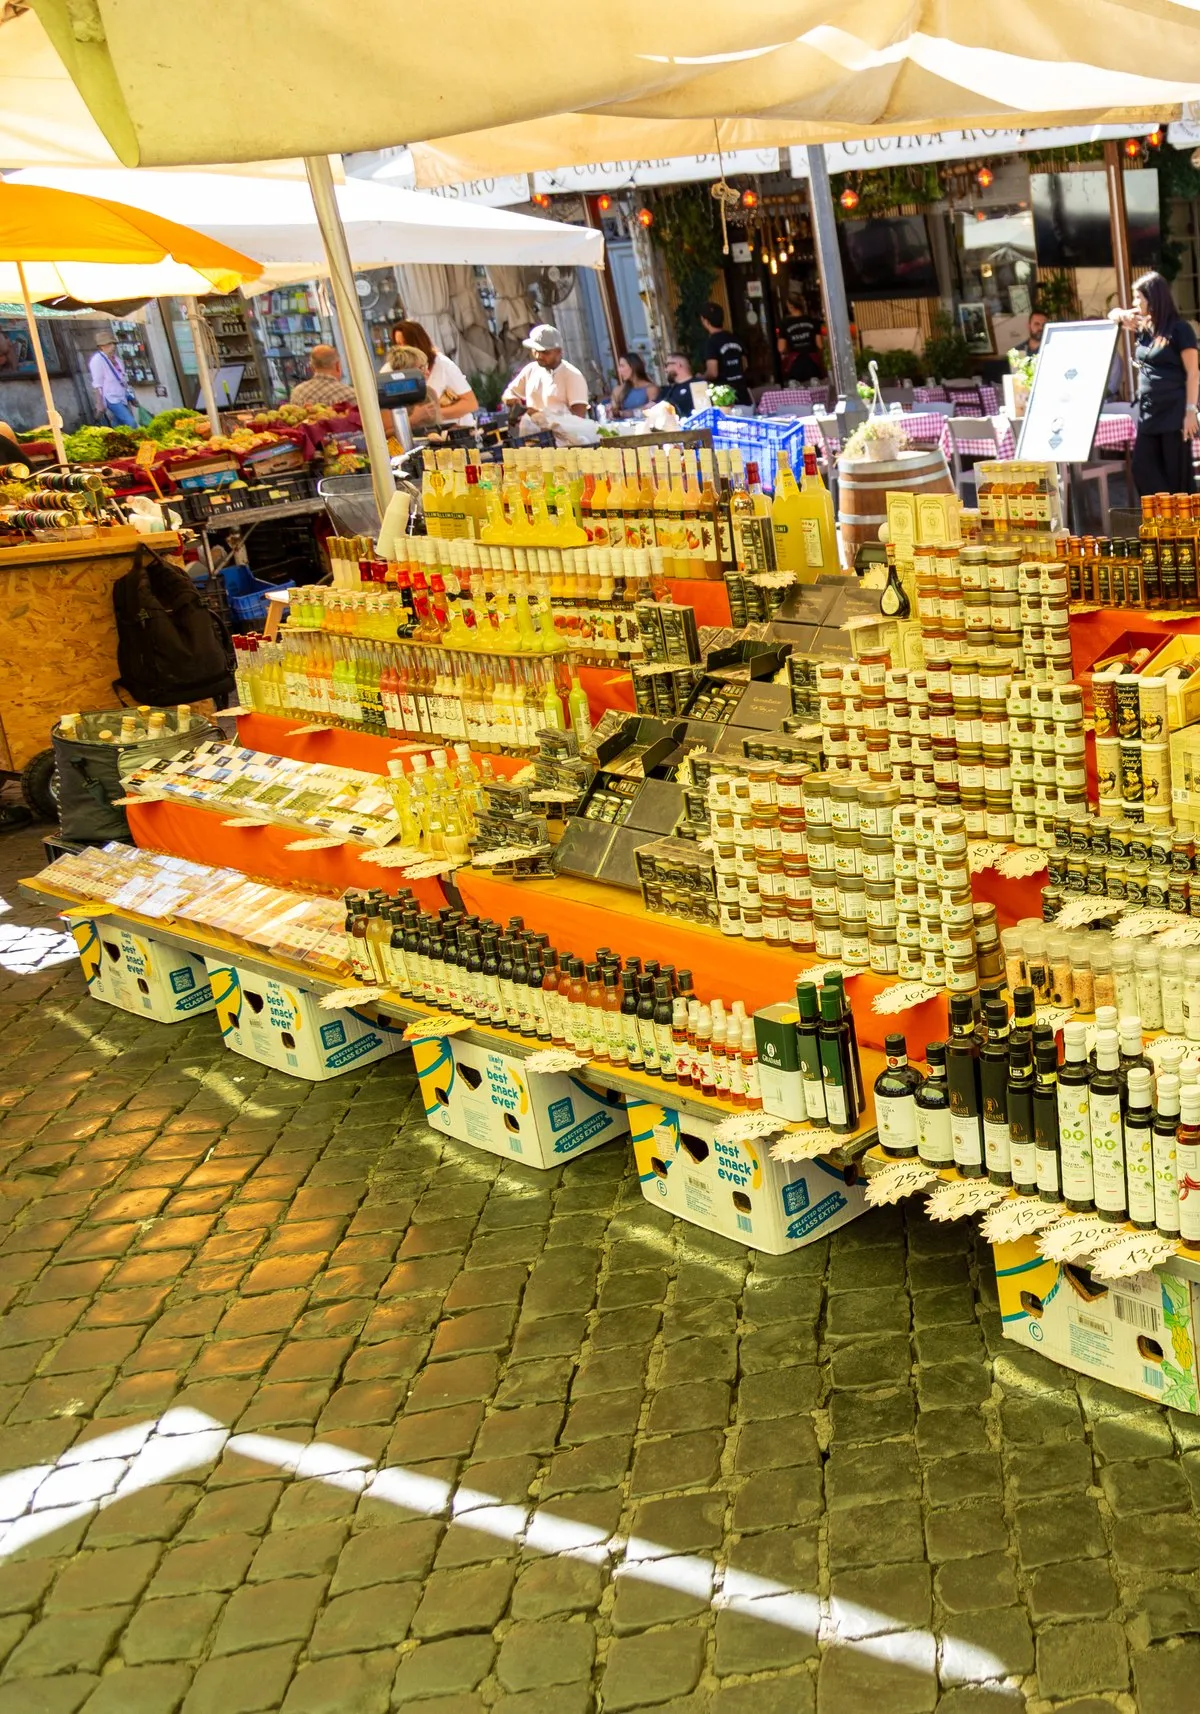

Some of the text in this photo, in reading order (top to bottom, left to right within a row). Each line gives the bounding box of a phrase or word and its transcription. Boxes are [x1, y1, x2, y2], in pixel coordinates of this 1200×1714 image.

[126, 955, 144, 966] snack
[127, 965, 144, 975] ever
[180, 991, 203, 1005] SELECTED
[184, 996, 204, 1009] CLASS
[266, 993, 284, 1007] best
[270, 1007, 294, 1020] snack
[271, 1018, 291, 1030] ever
[330, 1035, 374, 1061] SELECTED QUALITY
[335, 1041, 376, 1066] CLASS EXTRA
[486, 1068, 508, 1084] best
[491, 1083, 519, 1100] snack
[491, 1095, 516, 1110] ever
[560, 1114, 604, 1145] SELECTED QUALITY
[563, 1120, 606, 1150] CLASS EXTRA
[714, 1138, 740, 1159] best
[718, 1156, 752, 1177] snack
[872, 1163, 896, 1179] NUOVI
[717, 1168, 748, 1187] ever
[893, 1170, 937, 1187] 25,00
[935, 1184, 959, 1195] NUOVI
[954, 1189, 1000, 1207] 25,00
[791, 1195, 839, 1230] SELECTED QUALITY
[987, 1203, 1013, 1217] NUOVI
[1011, 1206, 1056, 1227] 15,00
[796, 1201, 840, 1240] CLASS EXTRA
[1043, 1219, 1076, 1233] NUOVI
[1070, 1227, 1118, 1247] 20,00
[1127, 1242, 1172, 1264] 13,00
